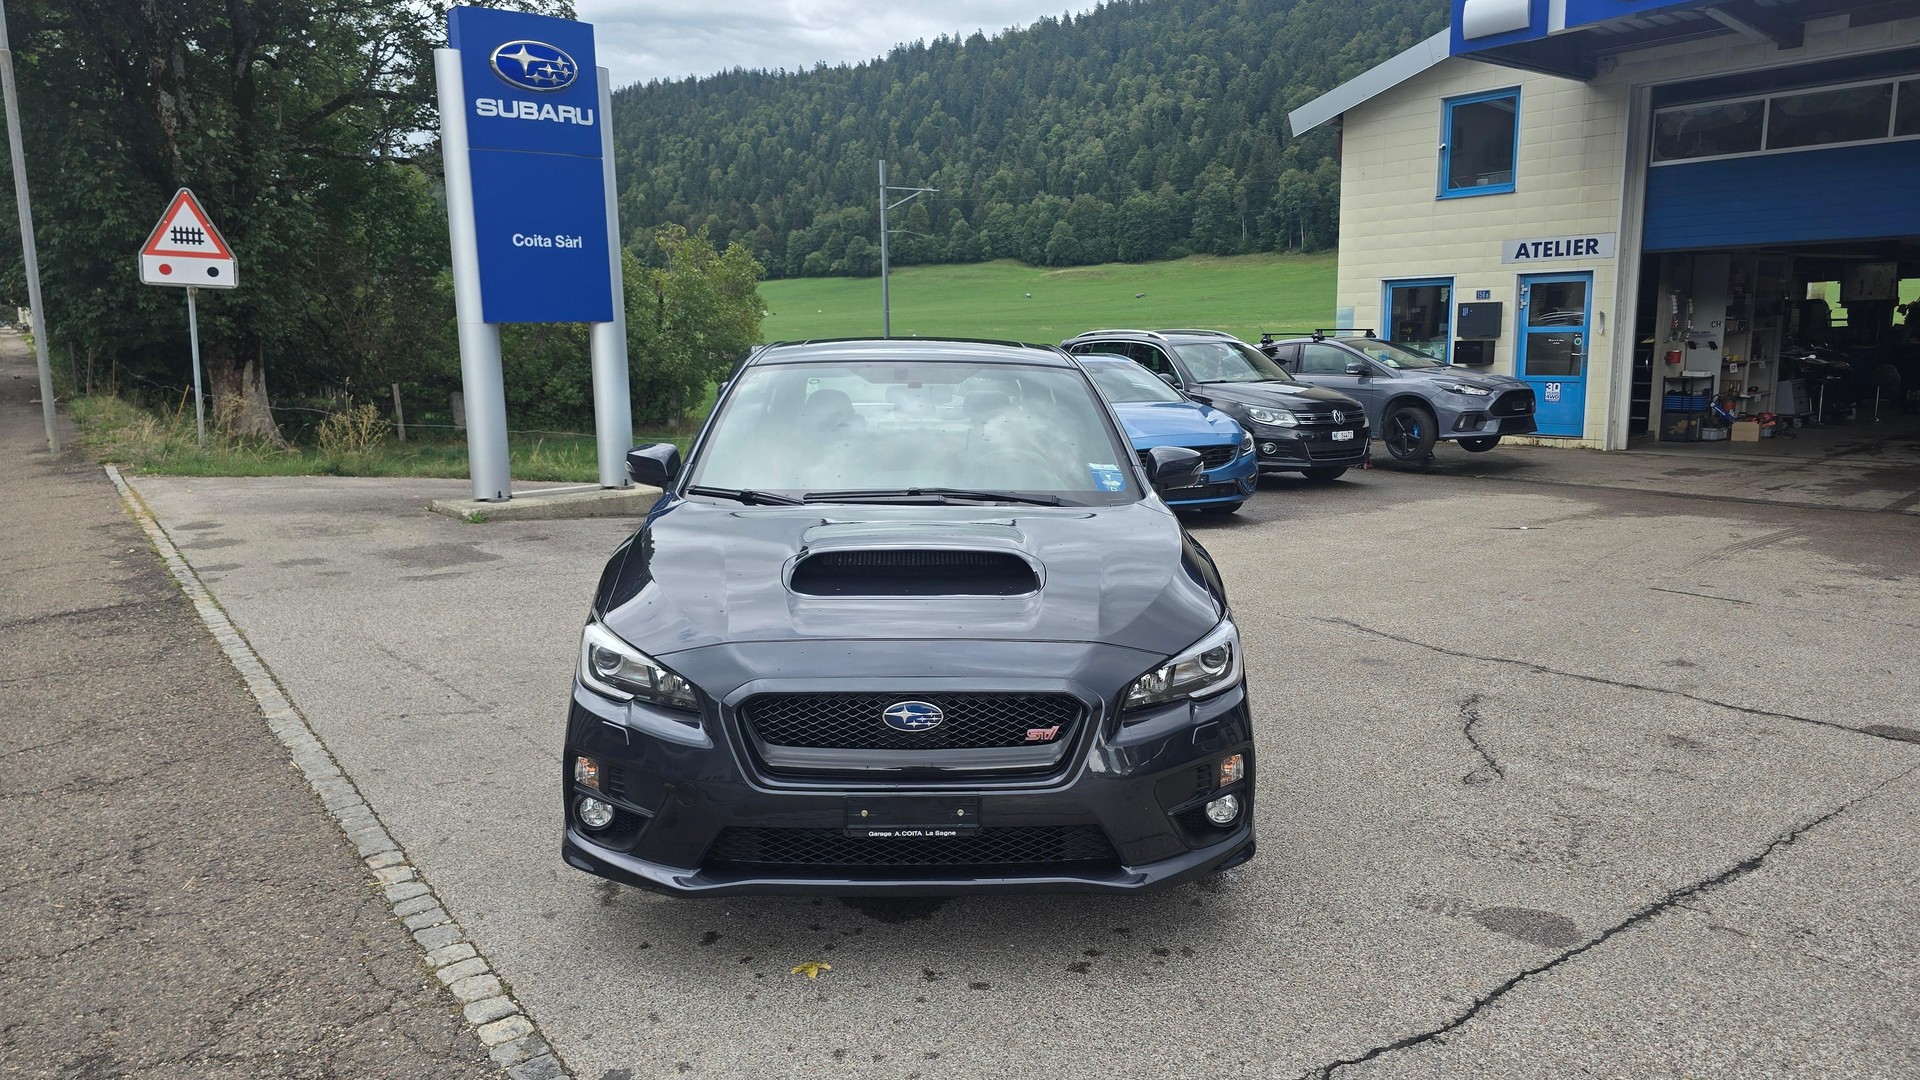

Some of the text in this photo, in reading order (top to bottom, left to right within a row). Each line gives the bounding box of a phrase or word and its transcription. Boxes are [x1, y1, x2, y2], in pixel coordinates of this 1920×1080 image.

[475, 98, 594, 126] SUBARU
[512, 233, 582, 249] Coita Sàrl
[1514, 238, 1599, 259] ATELIER
[1546, 382, 1560, 391] 30
